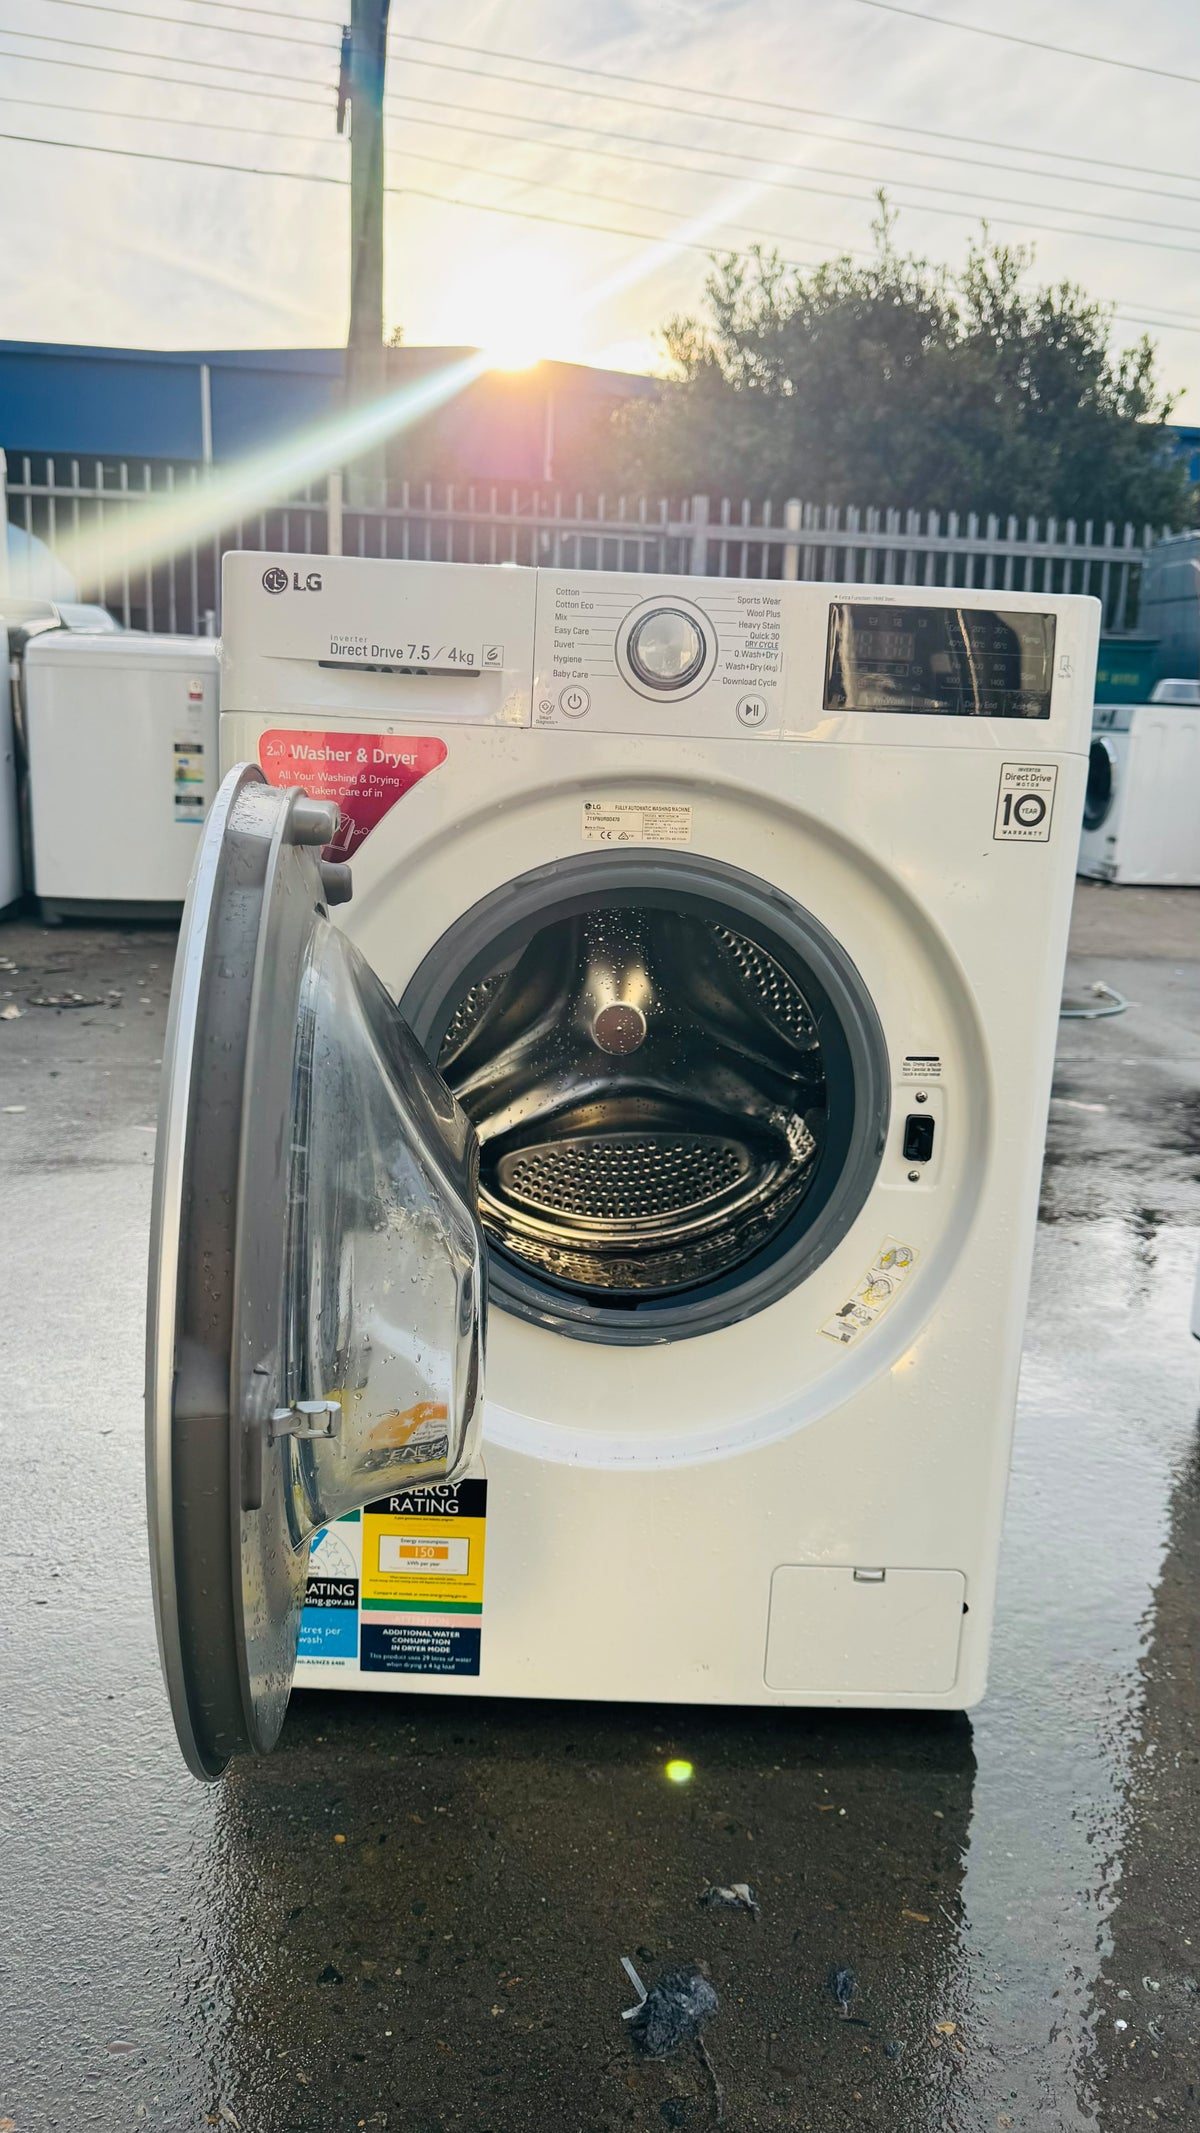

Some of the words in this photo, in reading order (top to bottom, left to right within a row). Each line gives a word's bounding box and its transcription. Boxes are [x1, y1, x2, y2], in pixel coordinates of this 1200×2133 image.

[293, 573, 322, 591] LG
[556, 588, 580, 596] Cotton
[555, 600, 579, 609] Cotton
[737, 596, 761, 605] Sports
[762, 597, 781, 606] Wear
[555, 613, 568, 621] Mix
[746, 609, 765, 618] Wool
[766, 610, 781, 618] Plus
[554, 626, 572, 635] Easy
[573, 627, 590, 635] Care
[738, 621, 760, 630] Heavy
[762, 622, 780, 630] Stain
[750, 631, 770, 640] Quick
[771, 633, 780, 641] 30
[553, 640, 575, 649] Duvet
[745, 640, 758, 648] DRY
[759, 641, 779, 649] CYCLE
[330, 642, 368, 657] Direct
[371, 644, 403, 659] Drive
[553, 654, 582, 664] Hygiene
[725, 662, 762, 672] Wash+Dry
[763, 664, 778, 672] (4kg)
[553, 669, 571, 679] Baby
[572, 670, 589, 679] Care
[722, 677, 757, 686] Download
[758, 678, 777, 687] Cycle
[290, 745, 352, 762] Washer
[356, 749, 368, 763] &
[373, 749, 418, 768] Dryer
[279, 771, 291, 780] All
[293, 771, 315, 780] Your
[317, 773, 358, 784] Washing
[360, 775, 368, 783] &
[369, 775, 400, 787] Drying
[1005, 773, 1029, 781] Direct
[1030, 774, 1052, 782] Drive
[311, 786, 337, 796] Taken
[338, 787, 360, 797] Care
[362, 788, 373, 797] of
[374, 788, 383, 797] in
[1003, 794, 1046, 827] 10
[401, 1483, 462, 1497] ERGY
[389, 1498, 459, 1514] RATING
[415, 1547, 435, 1558] 150
[306, 1583, 355, 1597] ATING
[305, 1596, 355, 1607] ting.gov.au
[325, 1628, 341, 1636] per
[383, 1628, 432, 1637] ADDITIONAL
[433, 1630, 460, 1638] WATER
[299, 1635, 323, 1645] wash
[392, 1637, 451, 1645] CONSUMPTION
[383, 1653, 407, 1661] product
[404, 1662, 422, 1670] drying
